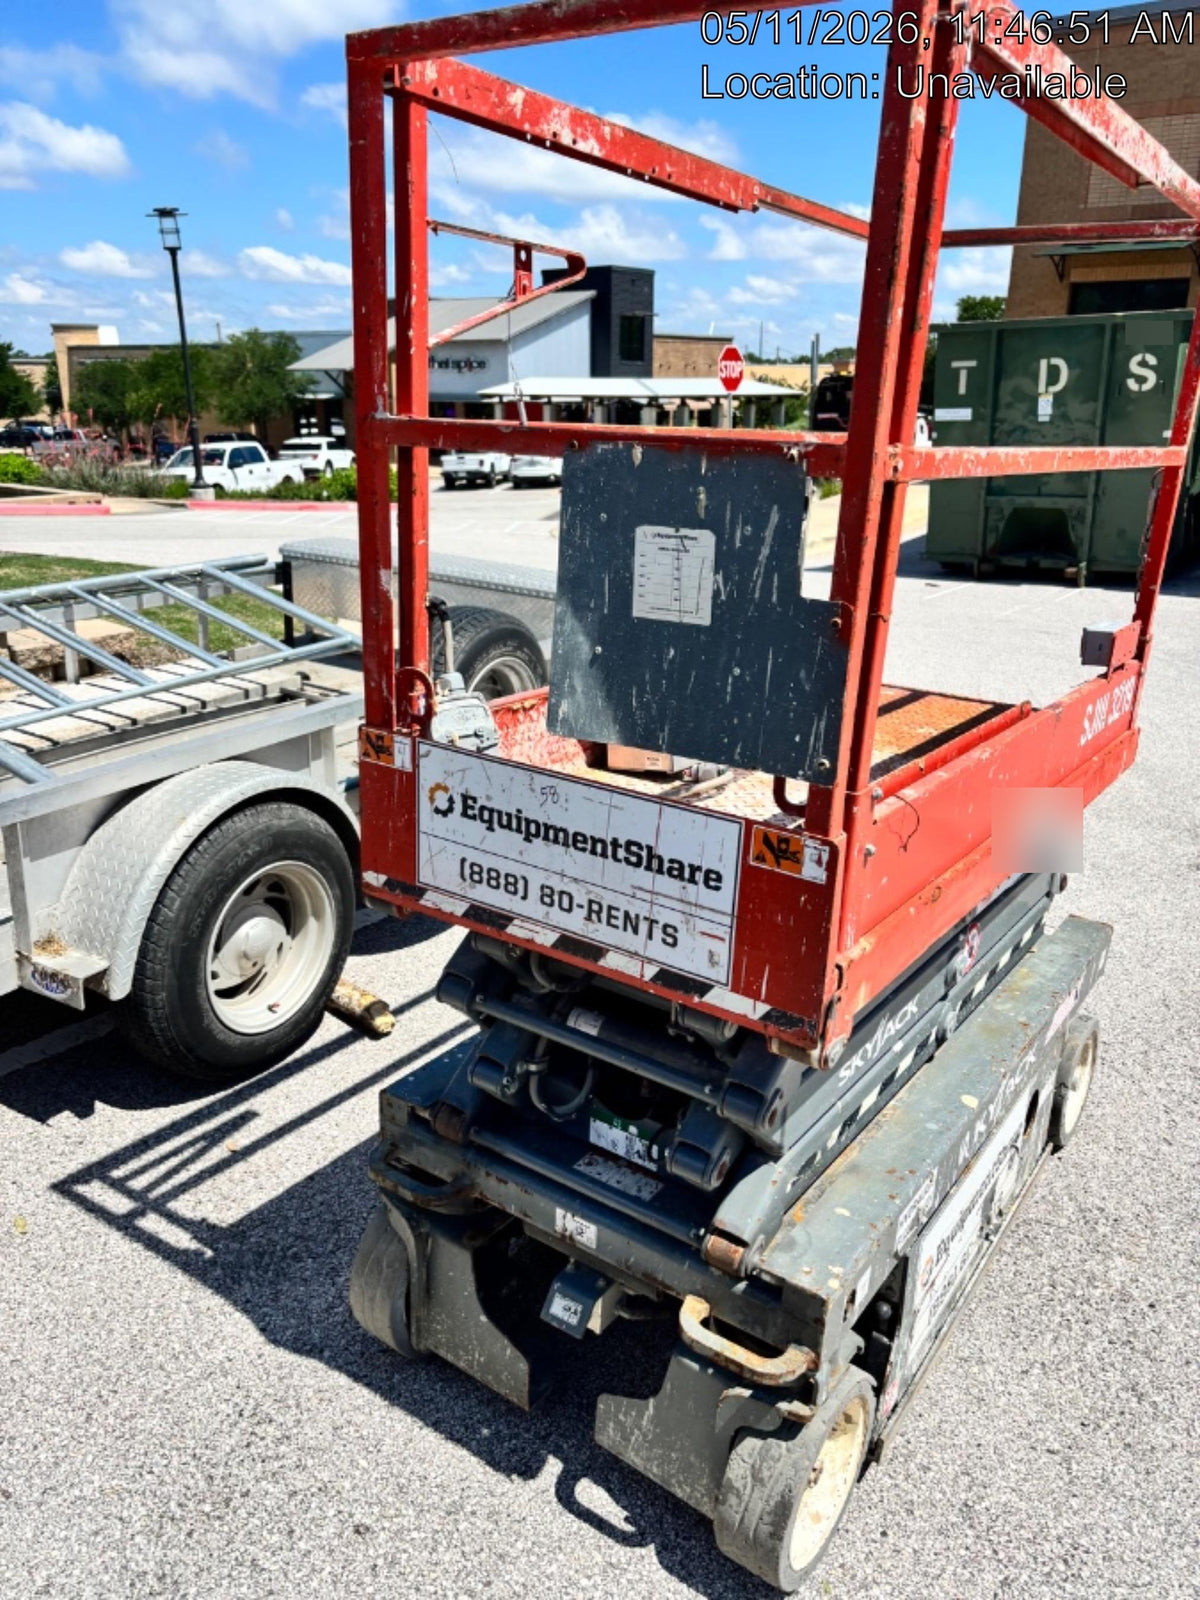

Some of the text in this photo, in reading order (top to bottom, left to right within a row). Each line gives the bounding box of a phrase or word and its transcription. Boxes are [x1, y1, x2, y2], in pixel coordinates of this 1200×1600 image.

[720, 361, 743, 378] STOP
[460, 791, 723, 892] EquipmentShare
[459, 857, 680, 949] (888) 80-RENTS
[838, 992, 919, 1087] SKYJACK
